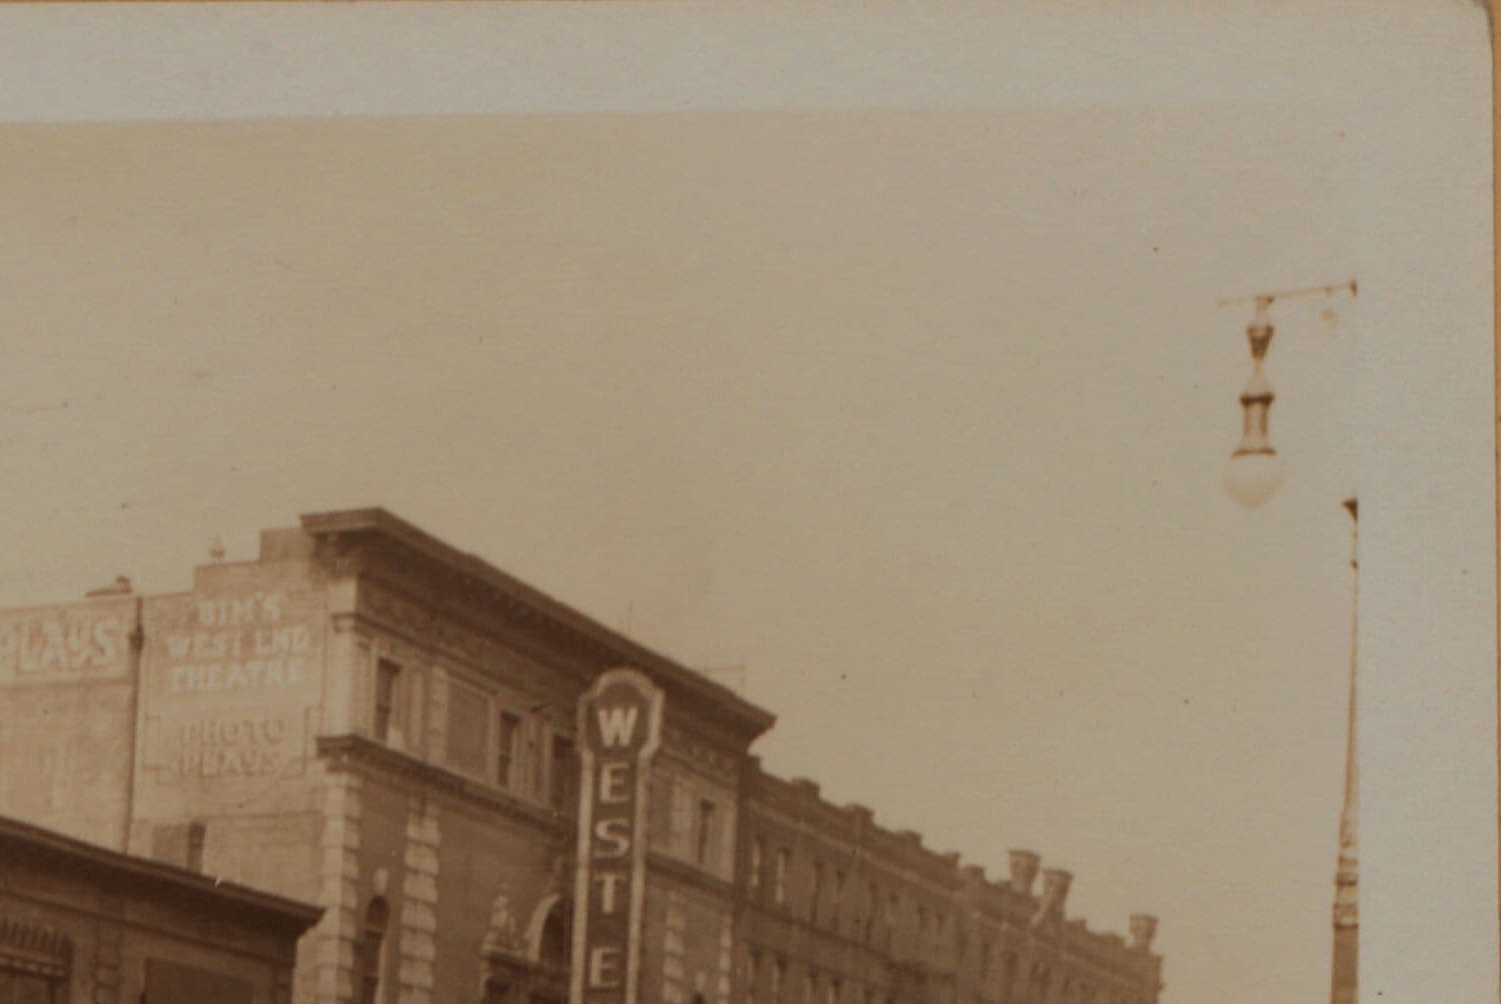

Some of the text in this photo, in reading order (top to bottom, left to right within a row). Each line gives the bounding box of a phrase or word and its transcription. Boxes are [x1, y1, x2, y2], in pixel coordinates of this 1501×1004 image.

[179, 718, 285, 749] PHOTO
[179, 748, 282, 778] PLAYS
[593, 705, 639, 916] WEST
